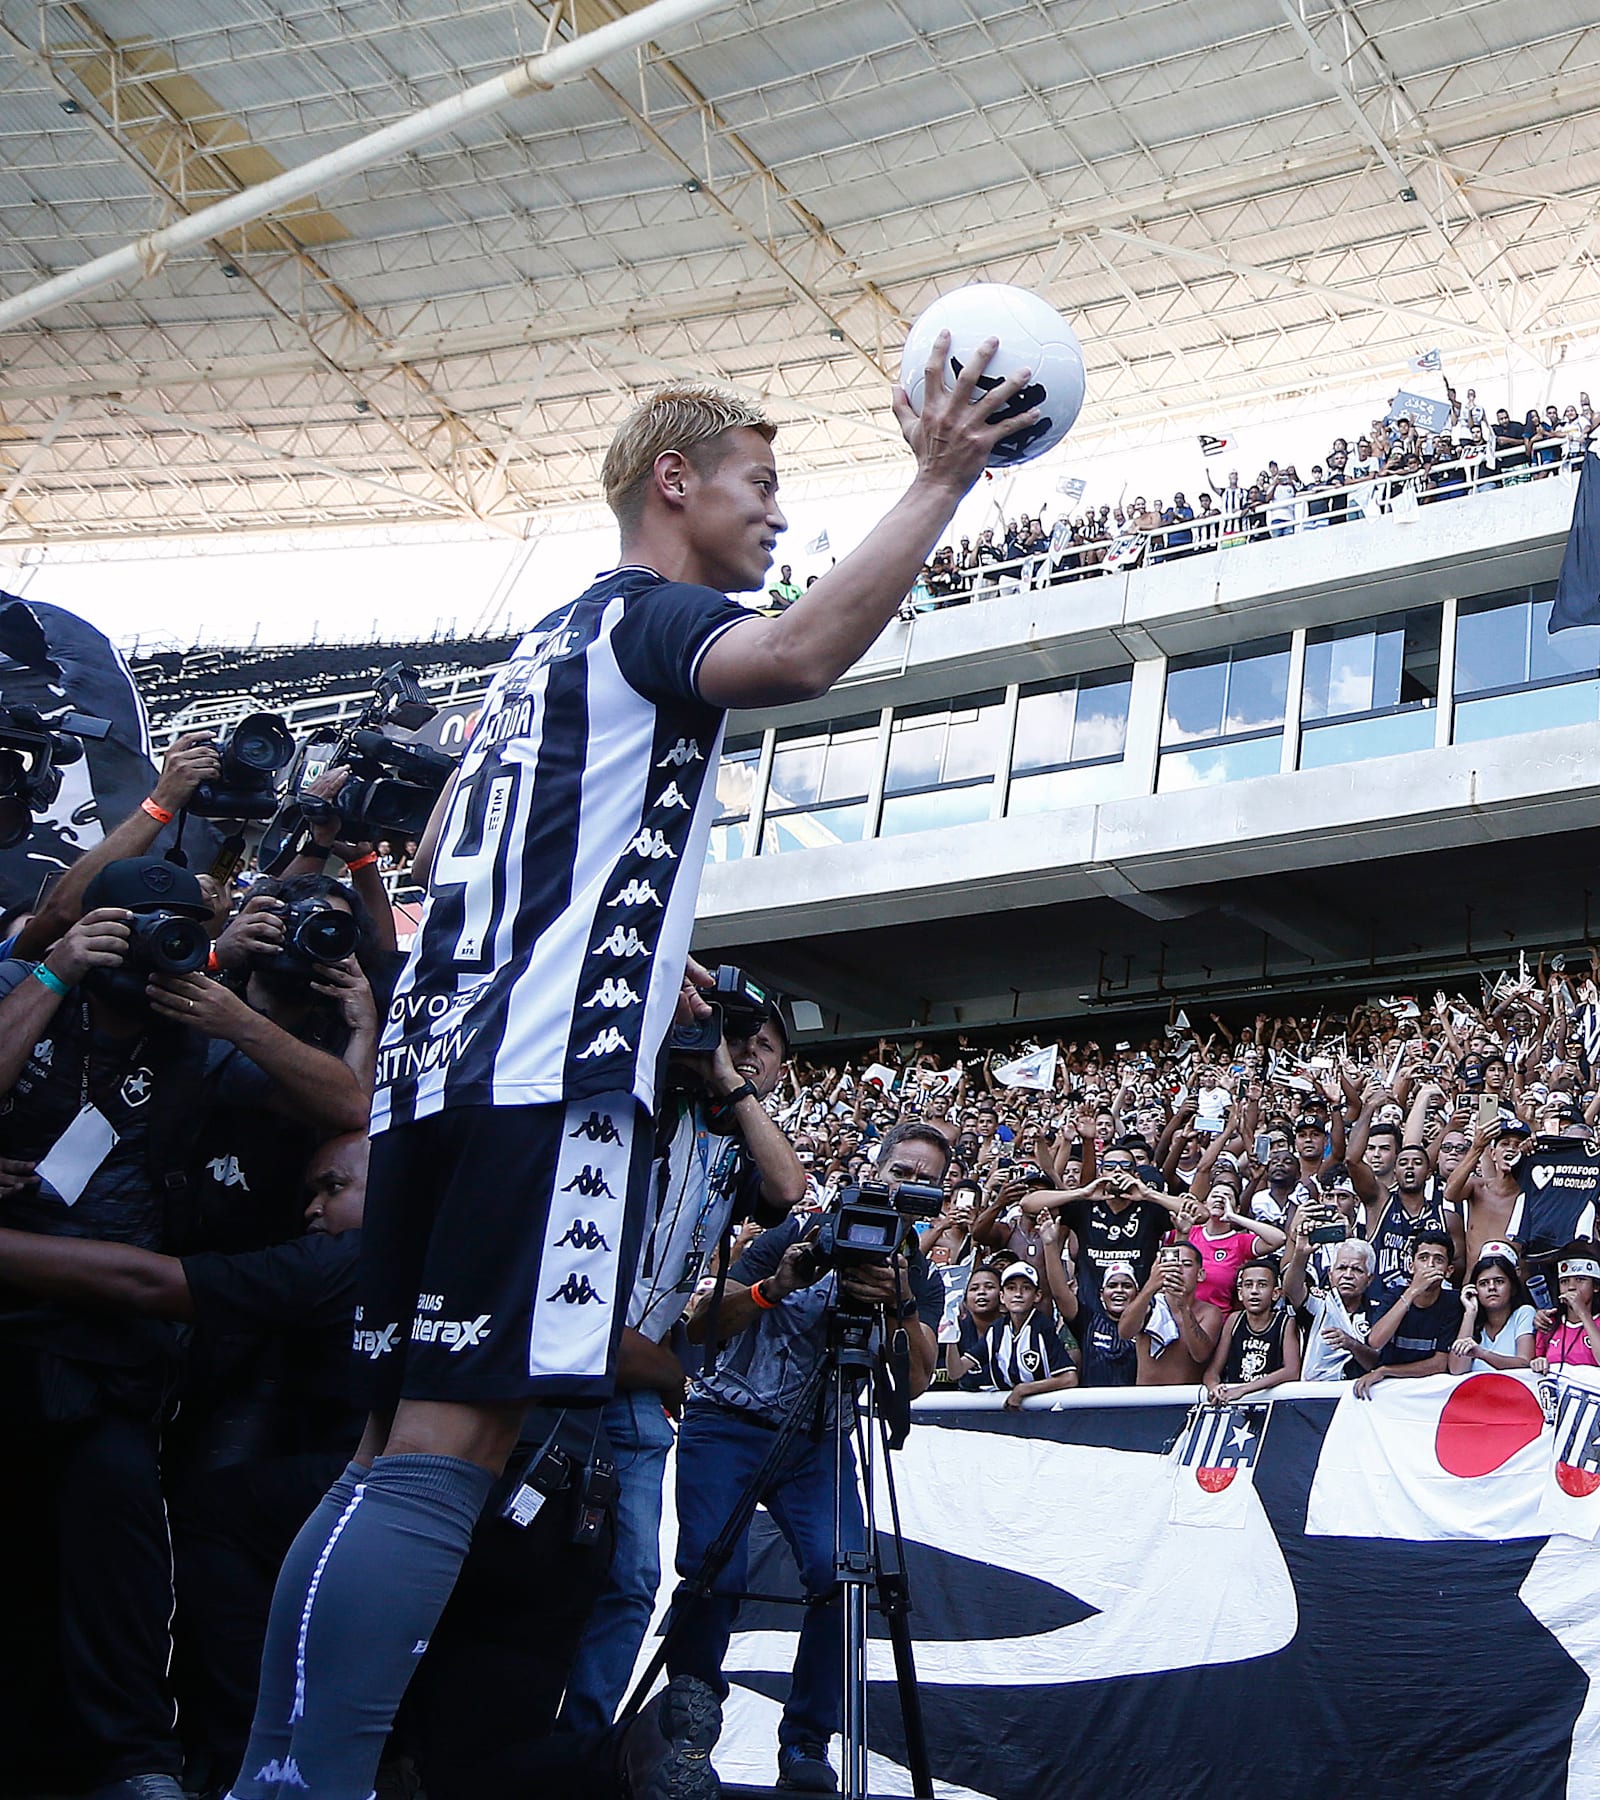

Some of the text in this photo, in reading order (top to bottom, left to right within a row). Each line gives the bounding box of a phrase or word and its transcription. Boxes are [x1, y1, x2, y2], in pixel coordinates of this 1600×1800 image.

[491, 788, 504, 814] TIM
[434, 775, 514, 961] 4
[1555, 1164, 1600, 1176] BOTAFOGO
[1552, 1177, 1564, 1187] NO
